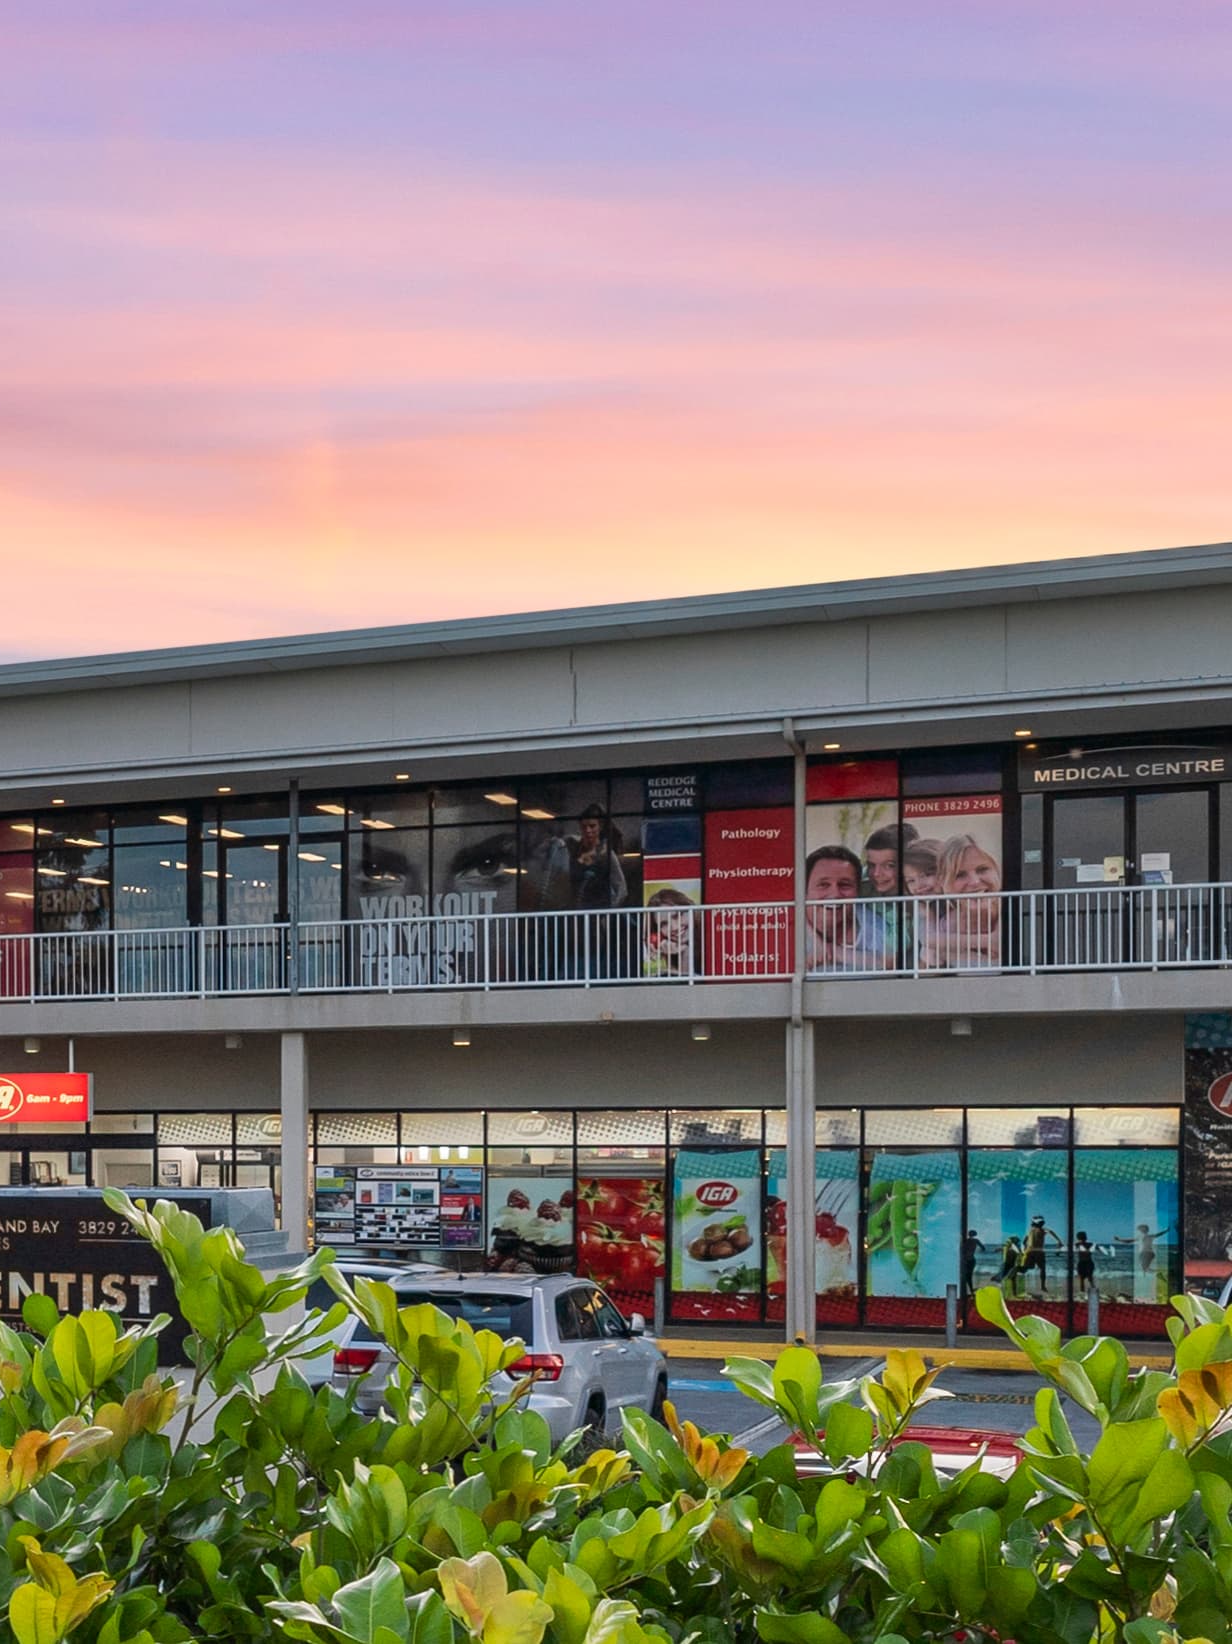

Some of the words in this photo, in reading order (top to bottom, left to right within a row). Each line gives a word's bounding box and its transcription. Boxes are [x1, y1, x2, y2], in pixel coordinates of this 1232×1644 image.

[1034, 765, 1130, 783] MEDICAL
[1136, 759, 1225, 777] CENTRE
[648, 786, 697, 798] MEDICAL
[651, 797, 693, 808] CENTRE
[904, 803, 940, 813] PHONE
[943, 801, 970, 811] 3829
[973, 799, 1000, 809] 2496
[721, 828, 781, 840] Pathology
[708, 867, 794, 879] Physiotherapy
[360, 891, 498, 922] WORKOUT
[402, 922, 474, 954] YOUR
[26, 1094, 50, 1103] 6am
[60, 1093, 84, 1104] 9pm
[517, 1119, 545, 1131] IGA
[1110, 1116, 1143, 1128] IGA
[700, 1186, 735, 1201] IGA
[32, 1220, 60, 1233] BAY
[78, 1221, 116, 1235] 3829
